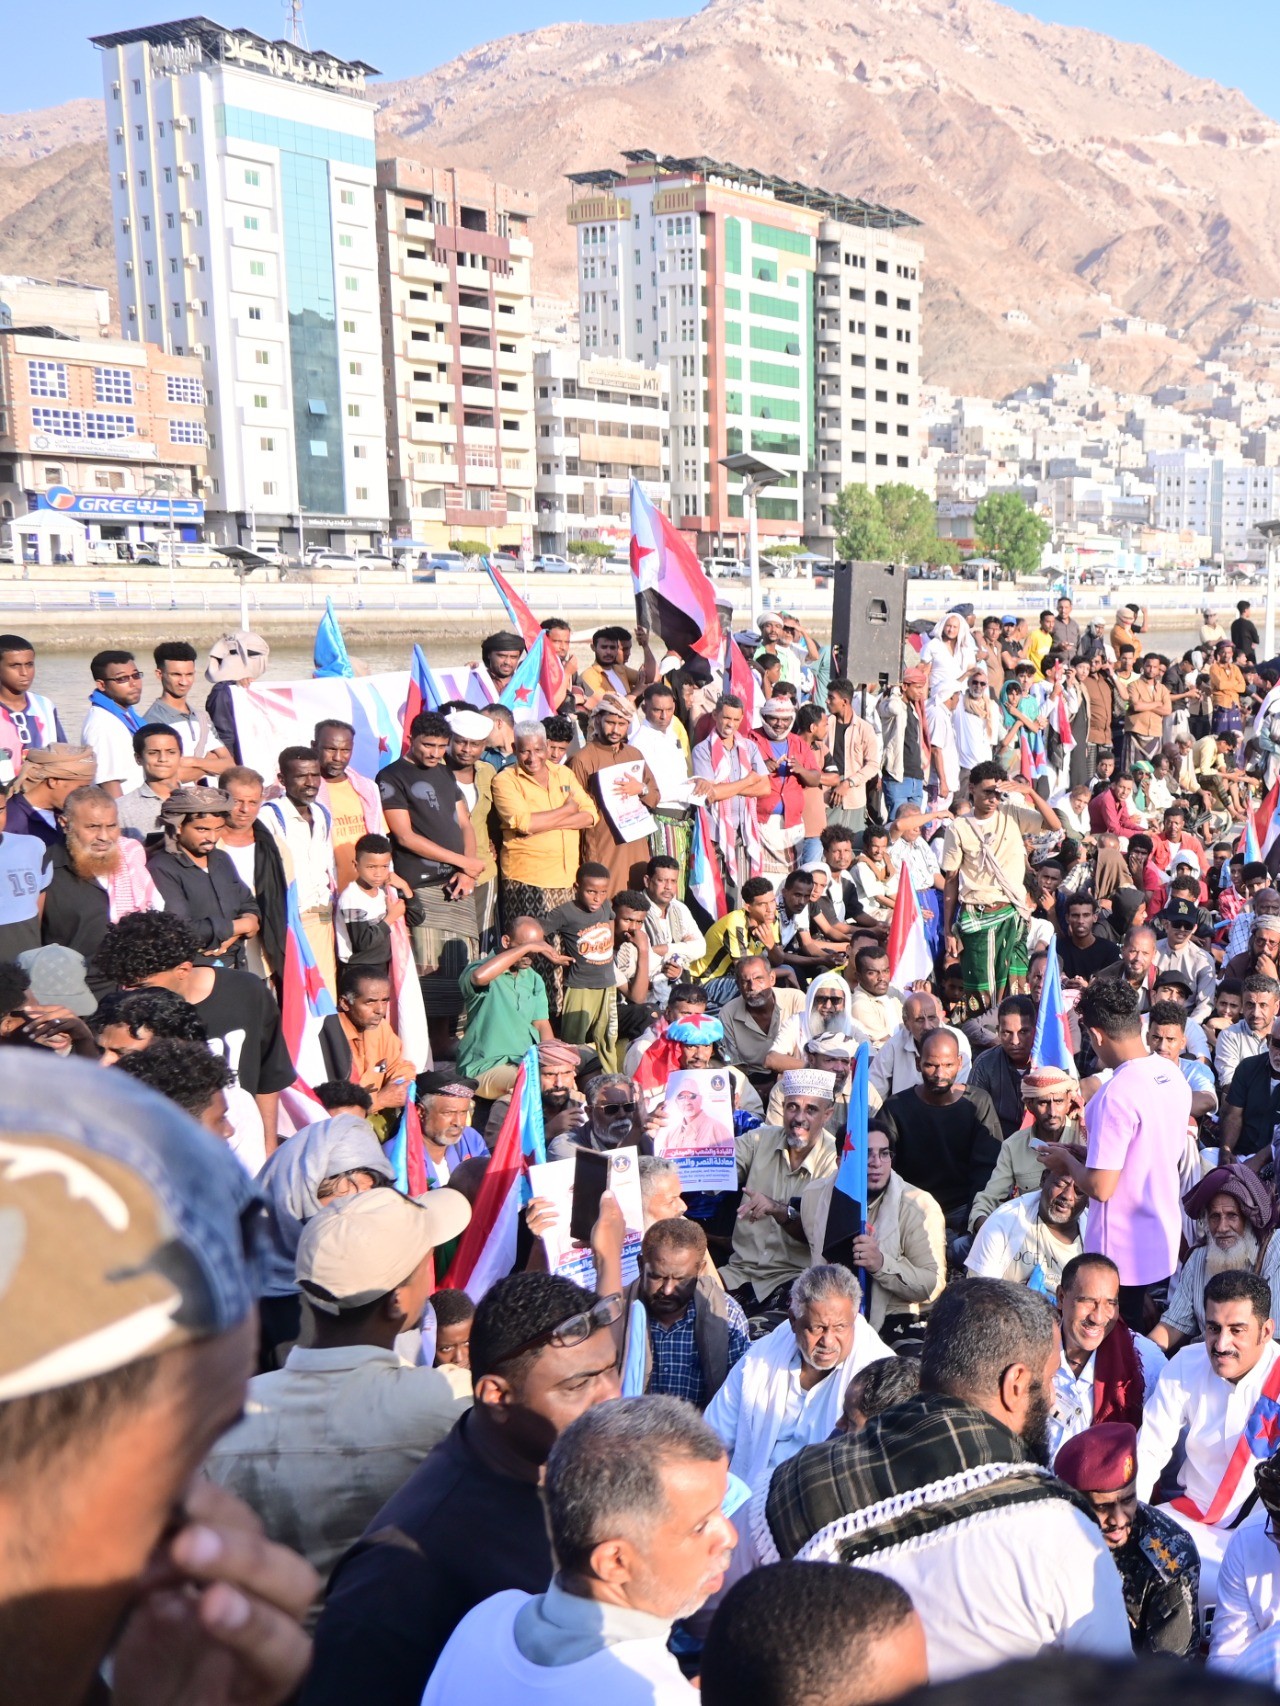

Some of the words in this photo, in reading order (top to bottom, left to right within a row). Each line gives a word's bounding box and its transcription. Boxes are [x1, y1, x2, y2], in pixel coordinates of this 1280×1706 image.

[78, 498, 136, 513] GREE
[8, 872, 38, 897] 19
[695, 1148, 716, 1157] والشعب
[716, 1148, 733, 1156] القيادة
[696, 1158, 714, 1167] النصر
[714, 1157, 734, 1166] معادلة
[1013, 1251, 1059, 1269] OCEAN
